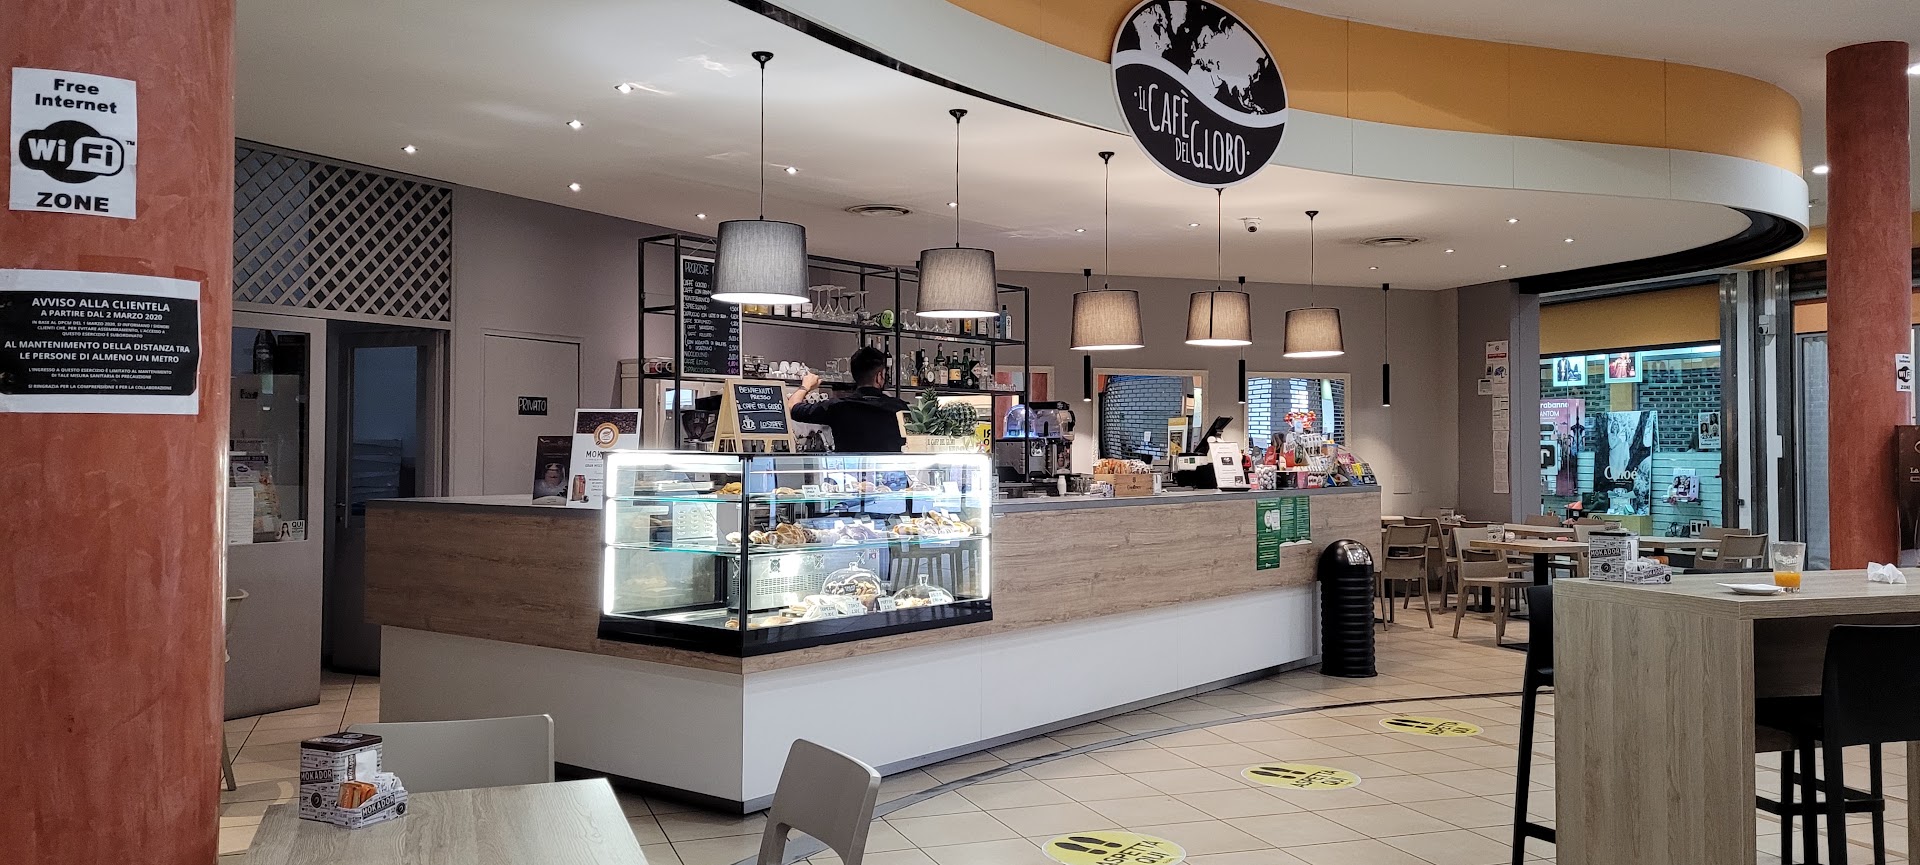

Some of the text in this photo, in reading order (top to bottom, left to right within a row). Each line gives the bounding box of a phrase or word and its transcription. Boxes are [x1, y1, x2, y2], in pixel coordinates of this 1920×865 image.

[54, 78, 100, 94] Free
[35, 93, 117, 114] Internet
[1138, 83, 1189, 138] IL CAFÈ
[1175, 120, 1246, 175] DEL GLOBO
[36, 192, 109, 212] ZONE
[32, 298, 170, 312] AVVISO ALLA CLIENTELA
[49, 310, 85, 318] PARTIRE
[113, 312, 144, 320] MARZO
[4, 341, 190, 353] AL MANTENIMENTO DELLA DISTANZA TRA
[19, 352, 31, 360] LE
[33, 352, 77, 360] PERSONE
[92, 353, 133, 361] ALMENO
[135, 354, 149, 362] UN
[151, 355, 179, 363] METRO
[739, 386, 774, 394] BENVENUTI
[518, 398, 546, 411] PRIVATO
[585, 450, 604, 458] MOK
[1604, 466, 1638, 480] Coé
[1591, 548, 1620, 556] MOKADOR
[1426, 721, 1458, 735] ASPETTA
[348, 754, 356, 780] MOKADOR
[301, 769, 332, 780] MOKADOR
[1290, 770, 1339, 788] ASPETTA
[1321, 777, 1348, 785] QUI
[362, 795, 395, 816] MOKADOR
[1096, 840, 1164, 865] ASPETTA
[1135, 851, 1170, 864] QUI
